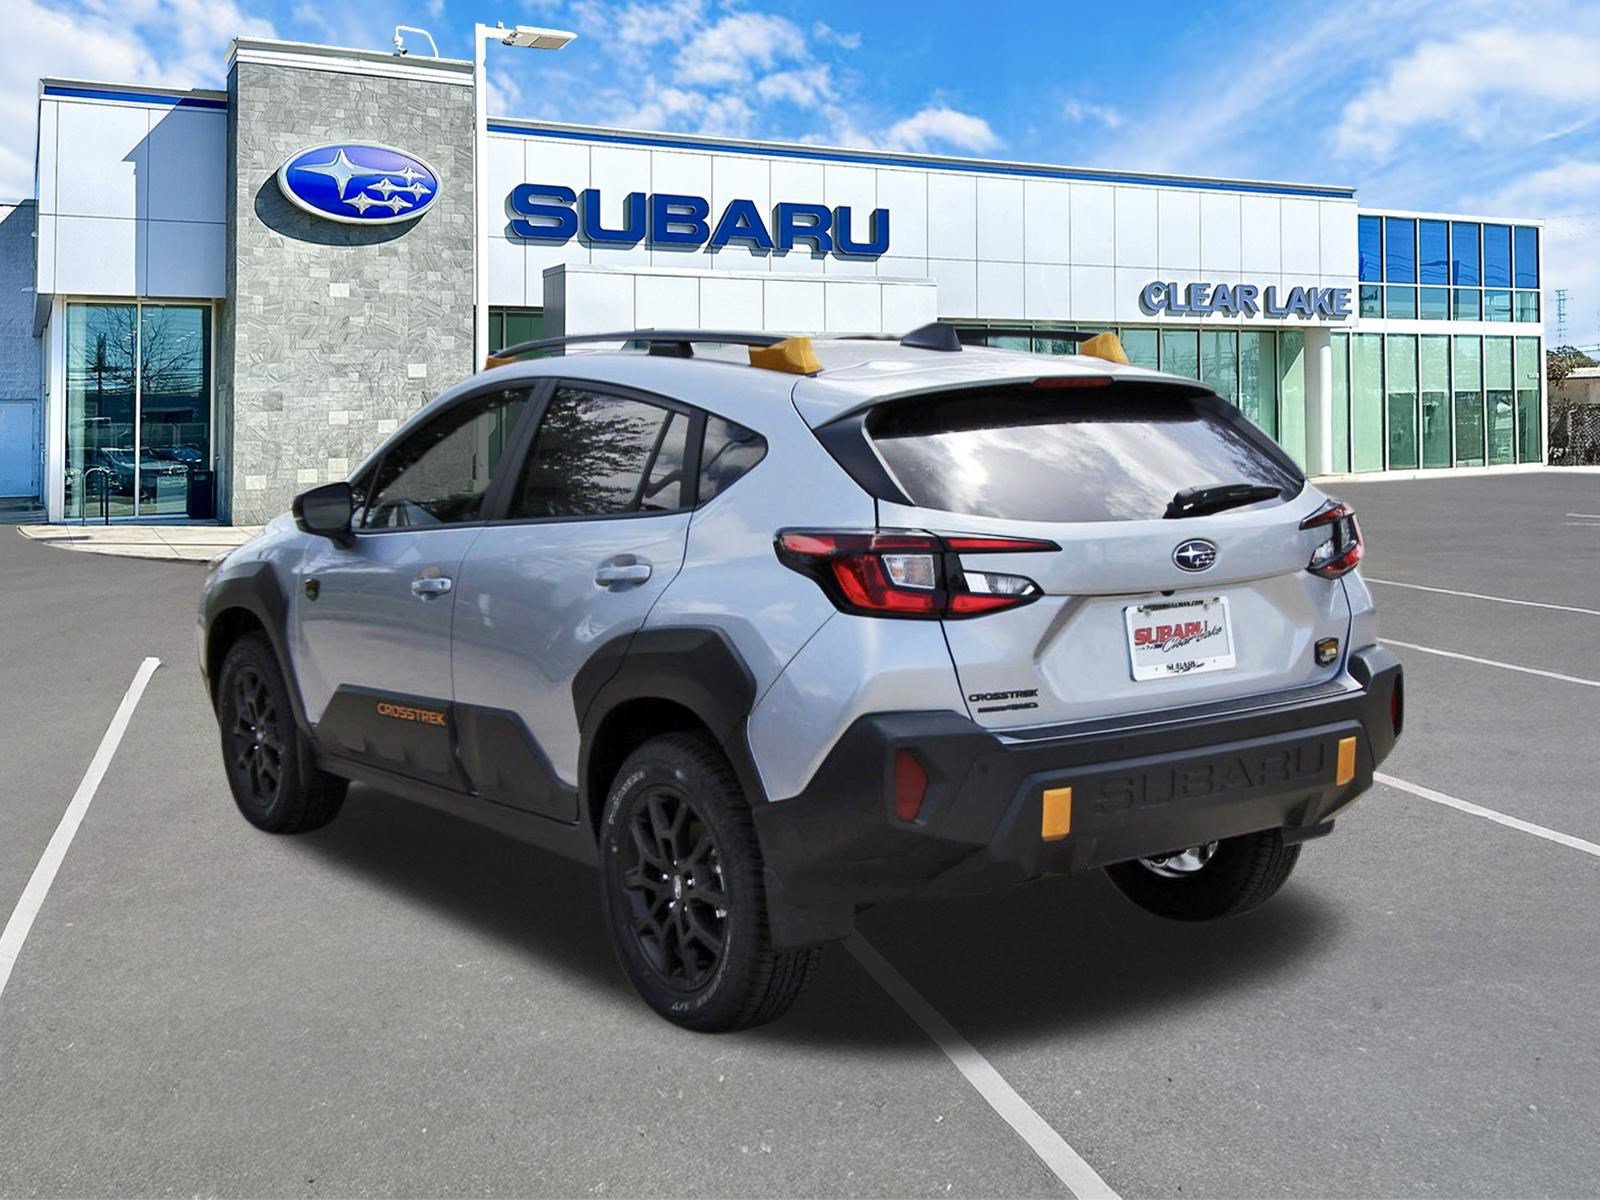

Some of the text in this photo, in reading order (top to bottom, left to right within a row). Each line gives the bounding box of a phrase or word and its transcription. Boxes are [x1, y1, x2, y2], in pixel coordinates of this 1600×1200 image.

[508, 183, 890, 258] SUBARU
[1141, 281, 1352, 317] CLEAR LAKE
[1134, 620, 1208, 646] SUBARU
[968, 688, 1039, 702] CROSSTREK
[376, 702, 447, 726] CROSSTREK
[1095, 742, 1325, 816] SUBARU
